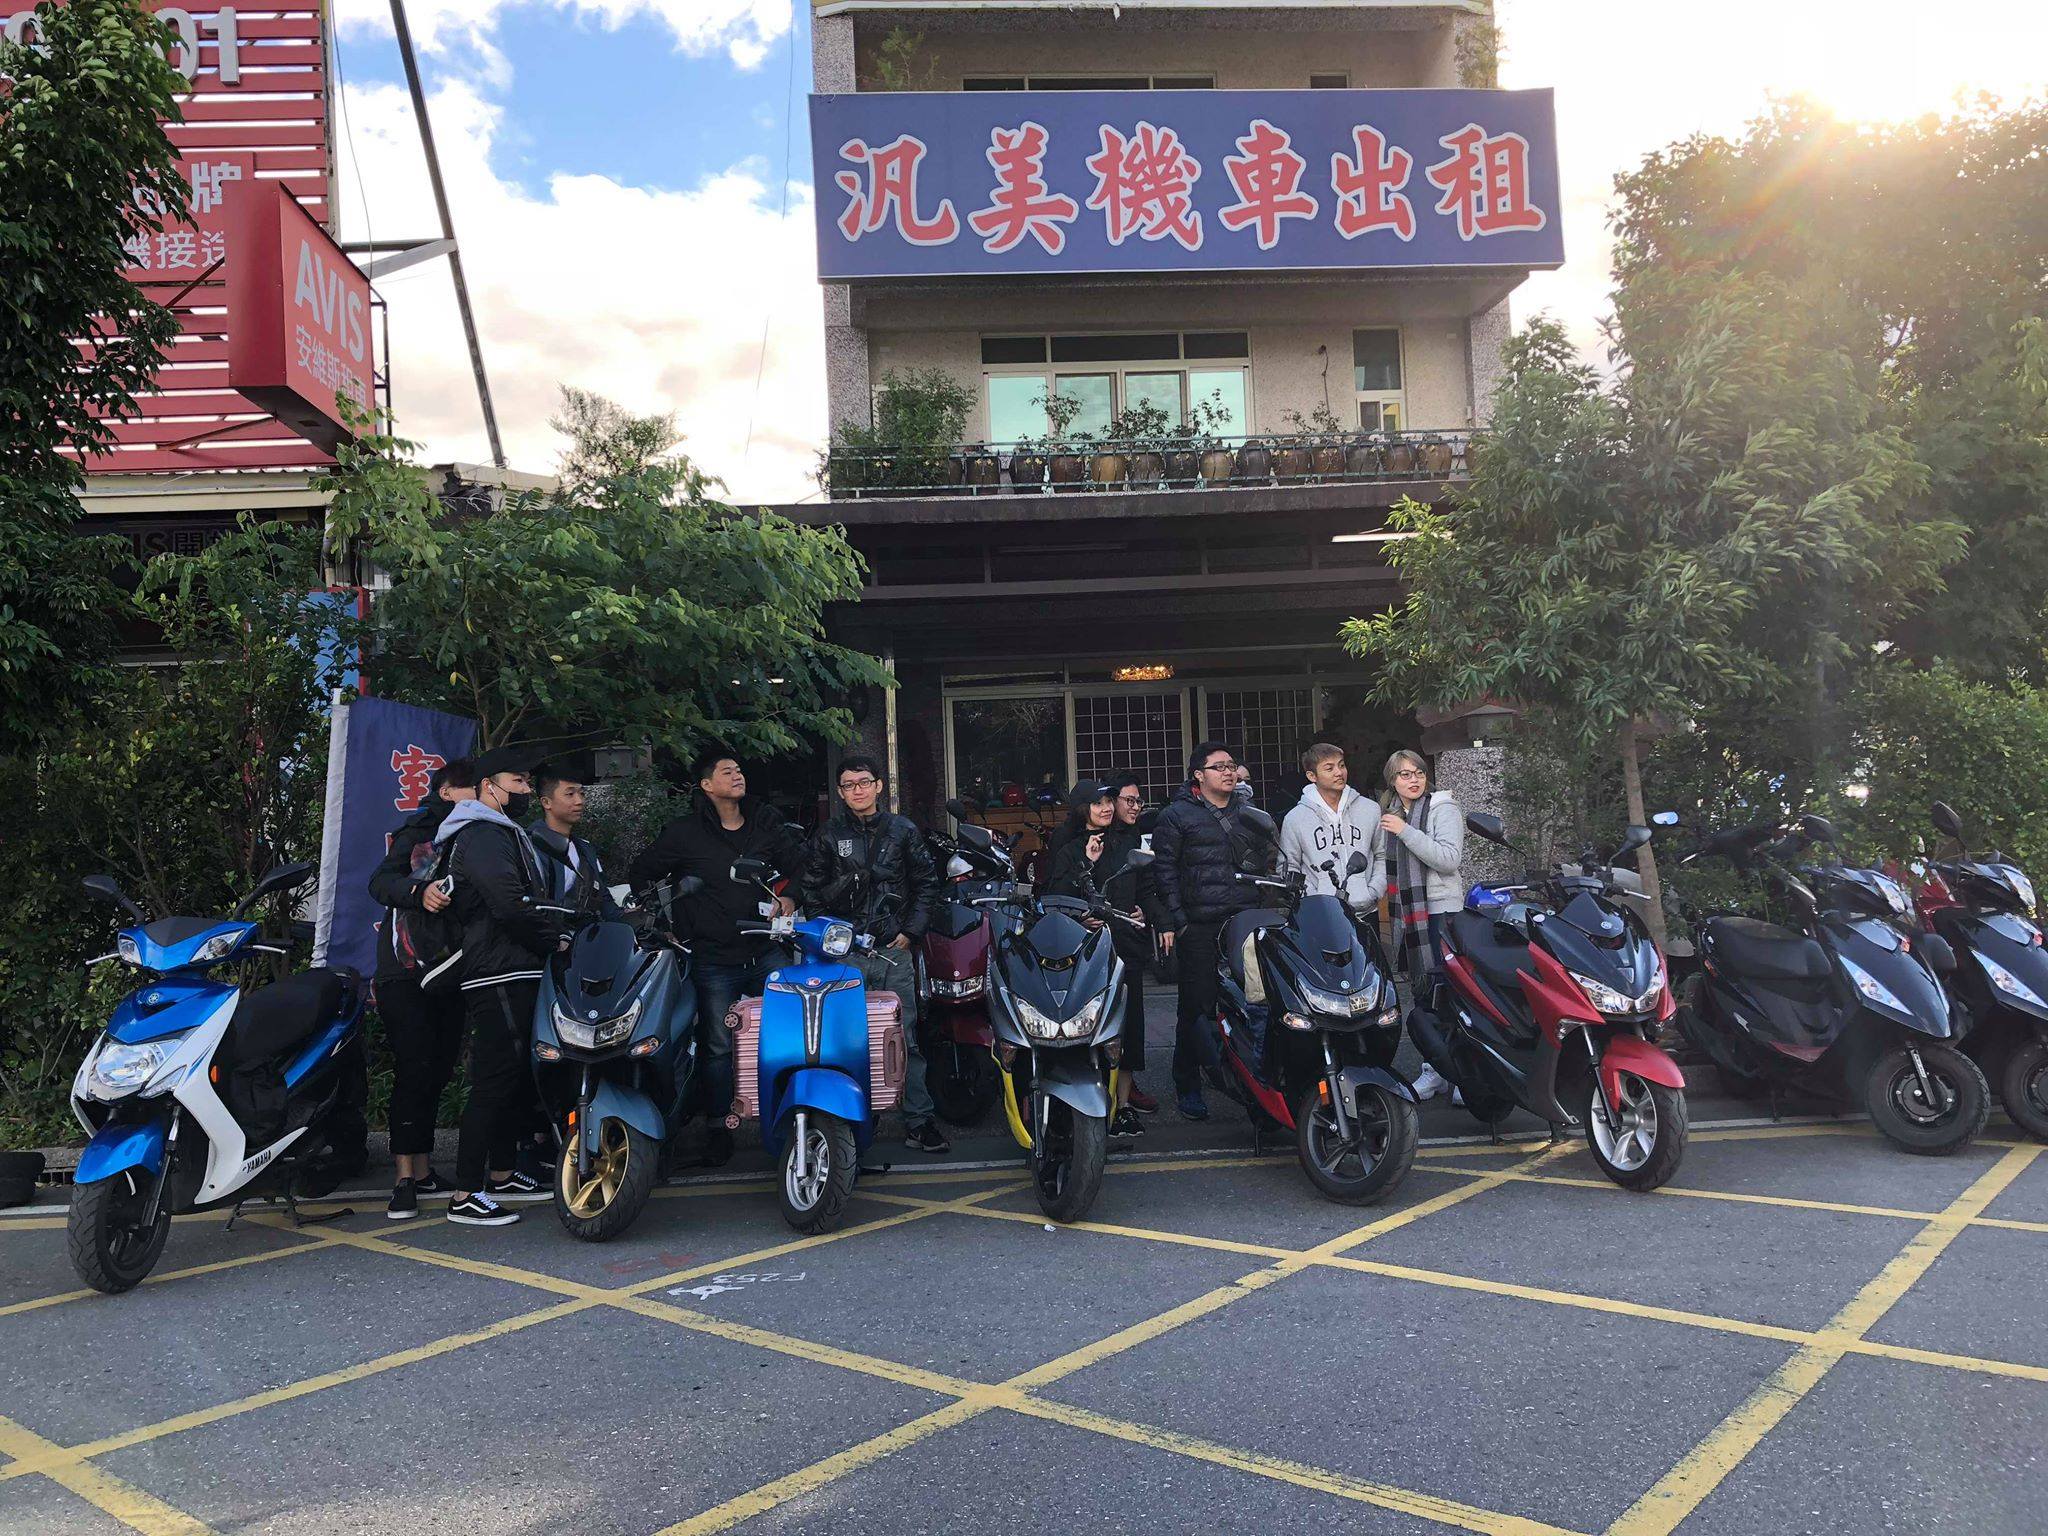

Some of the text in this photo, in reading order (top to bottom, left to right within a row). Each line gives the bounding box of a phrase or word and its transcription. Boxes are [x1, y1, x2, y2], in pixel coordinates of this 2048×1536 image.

[834, 120, 1547, 255] 汎美機車出租
[294, 239, 365, 363] AVIS
